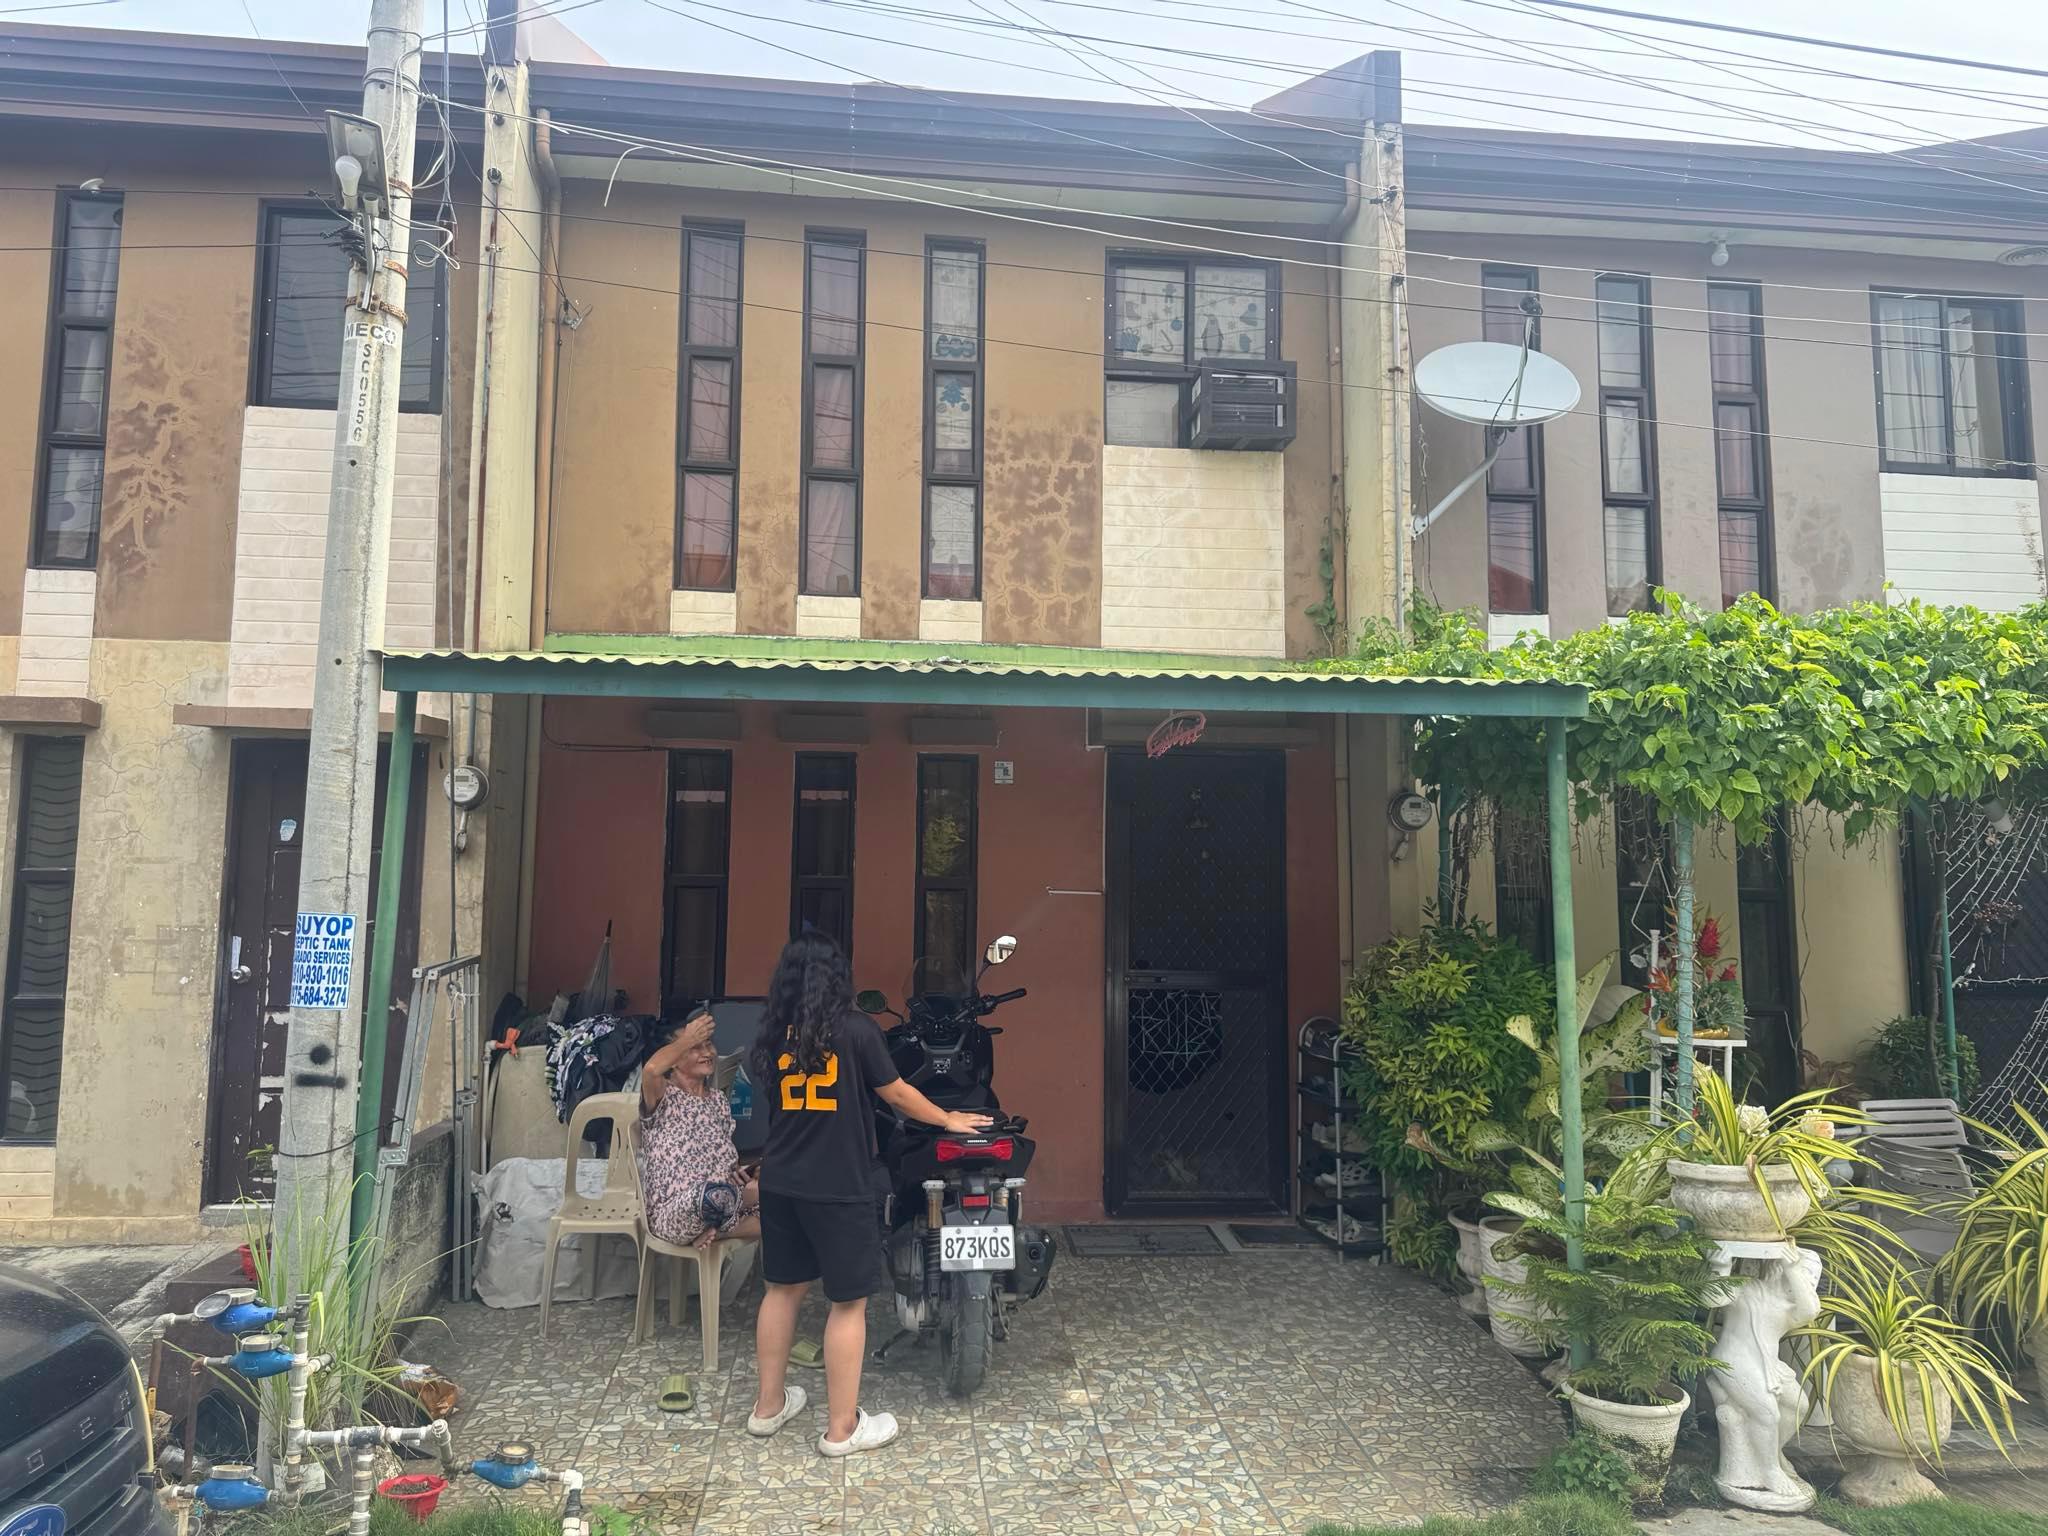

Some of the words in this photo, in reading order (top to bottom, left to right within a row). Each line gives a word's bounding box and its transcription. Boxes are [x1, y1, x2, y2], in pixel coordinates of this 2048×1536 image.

[323, 938, 351, 951] TANK
[313, 951, 351, 965] SERVICES
[778, 1053, 839, 1111] 22
[945, 1236, 1011, 1259] 873KQS
